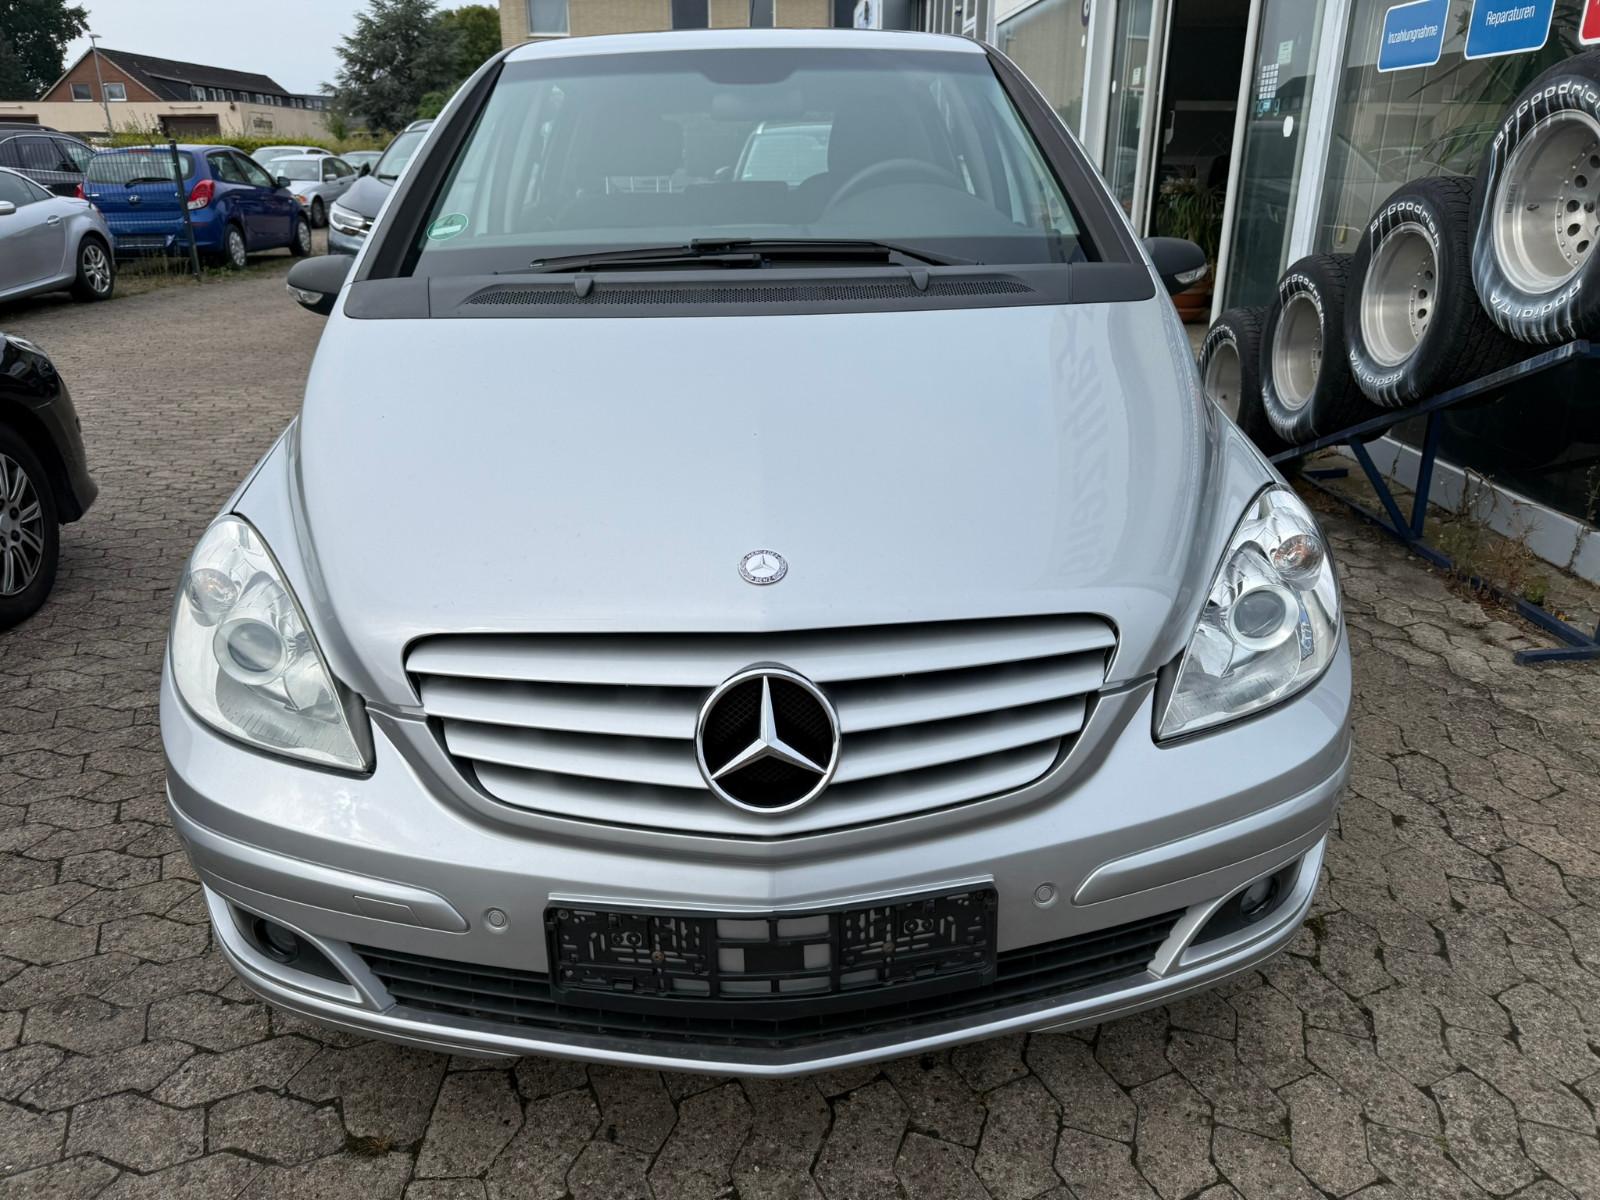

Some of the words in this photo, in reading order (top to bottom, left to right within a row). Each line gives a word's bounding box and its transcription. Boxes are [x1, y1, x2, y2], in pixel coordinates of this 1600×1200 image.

[1485, 5, 1536, 27] Reparaturen
[1388, 23, 1438, 45] Inzahlungnahme
[1370, 202, 1440, 248] BFGoodrich
